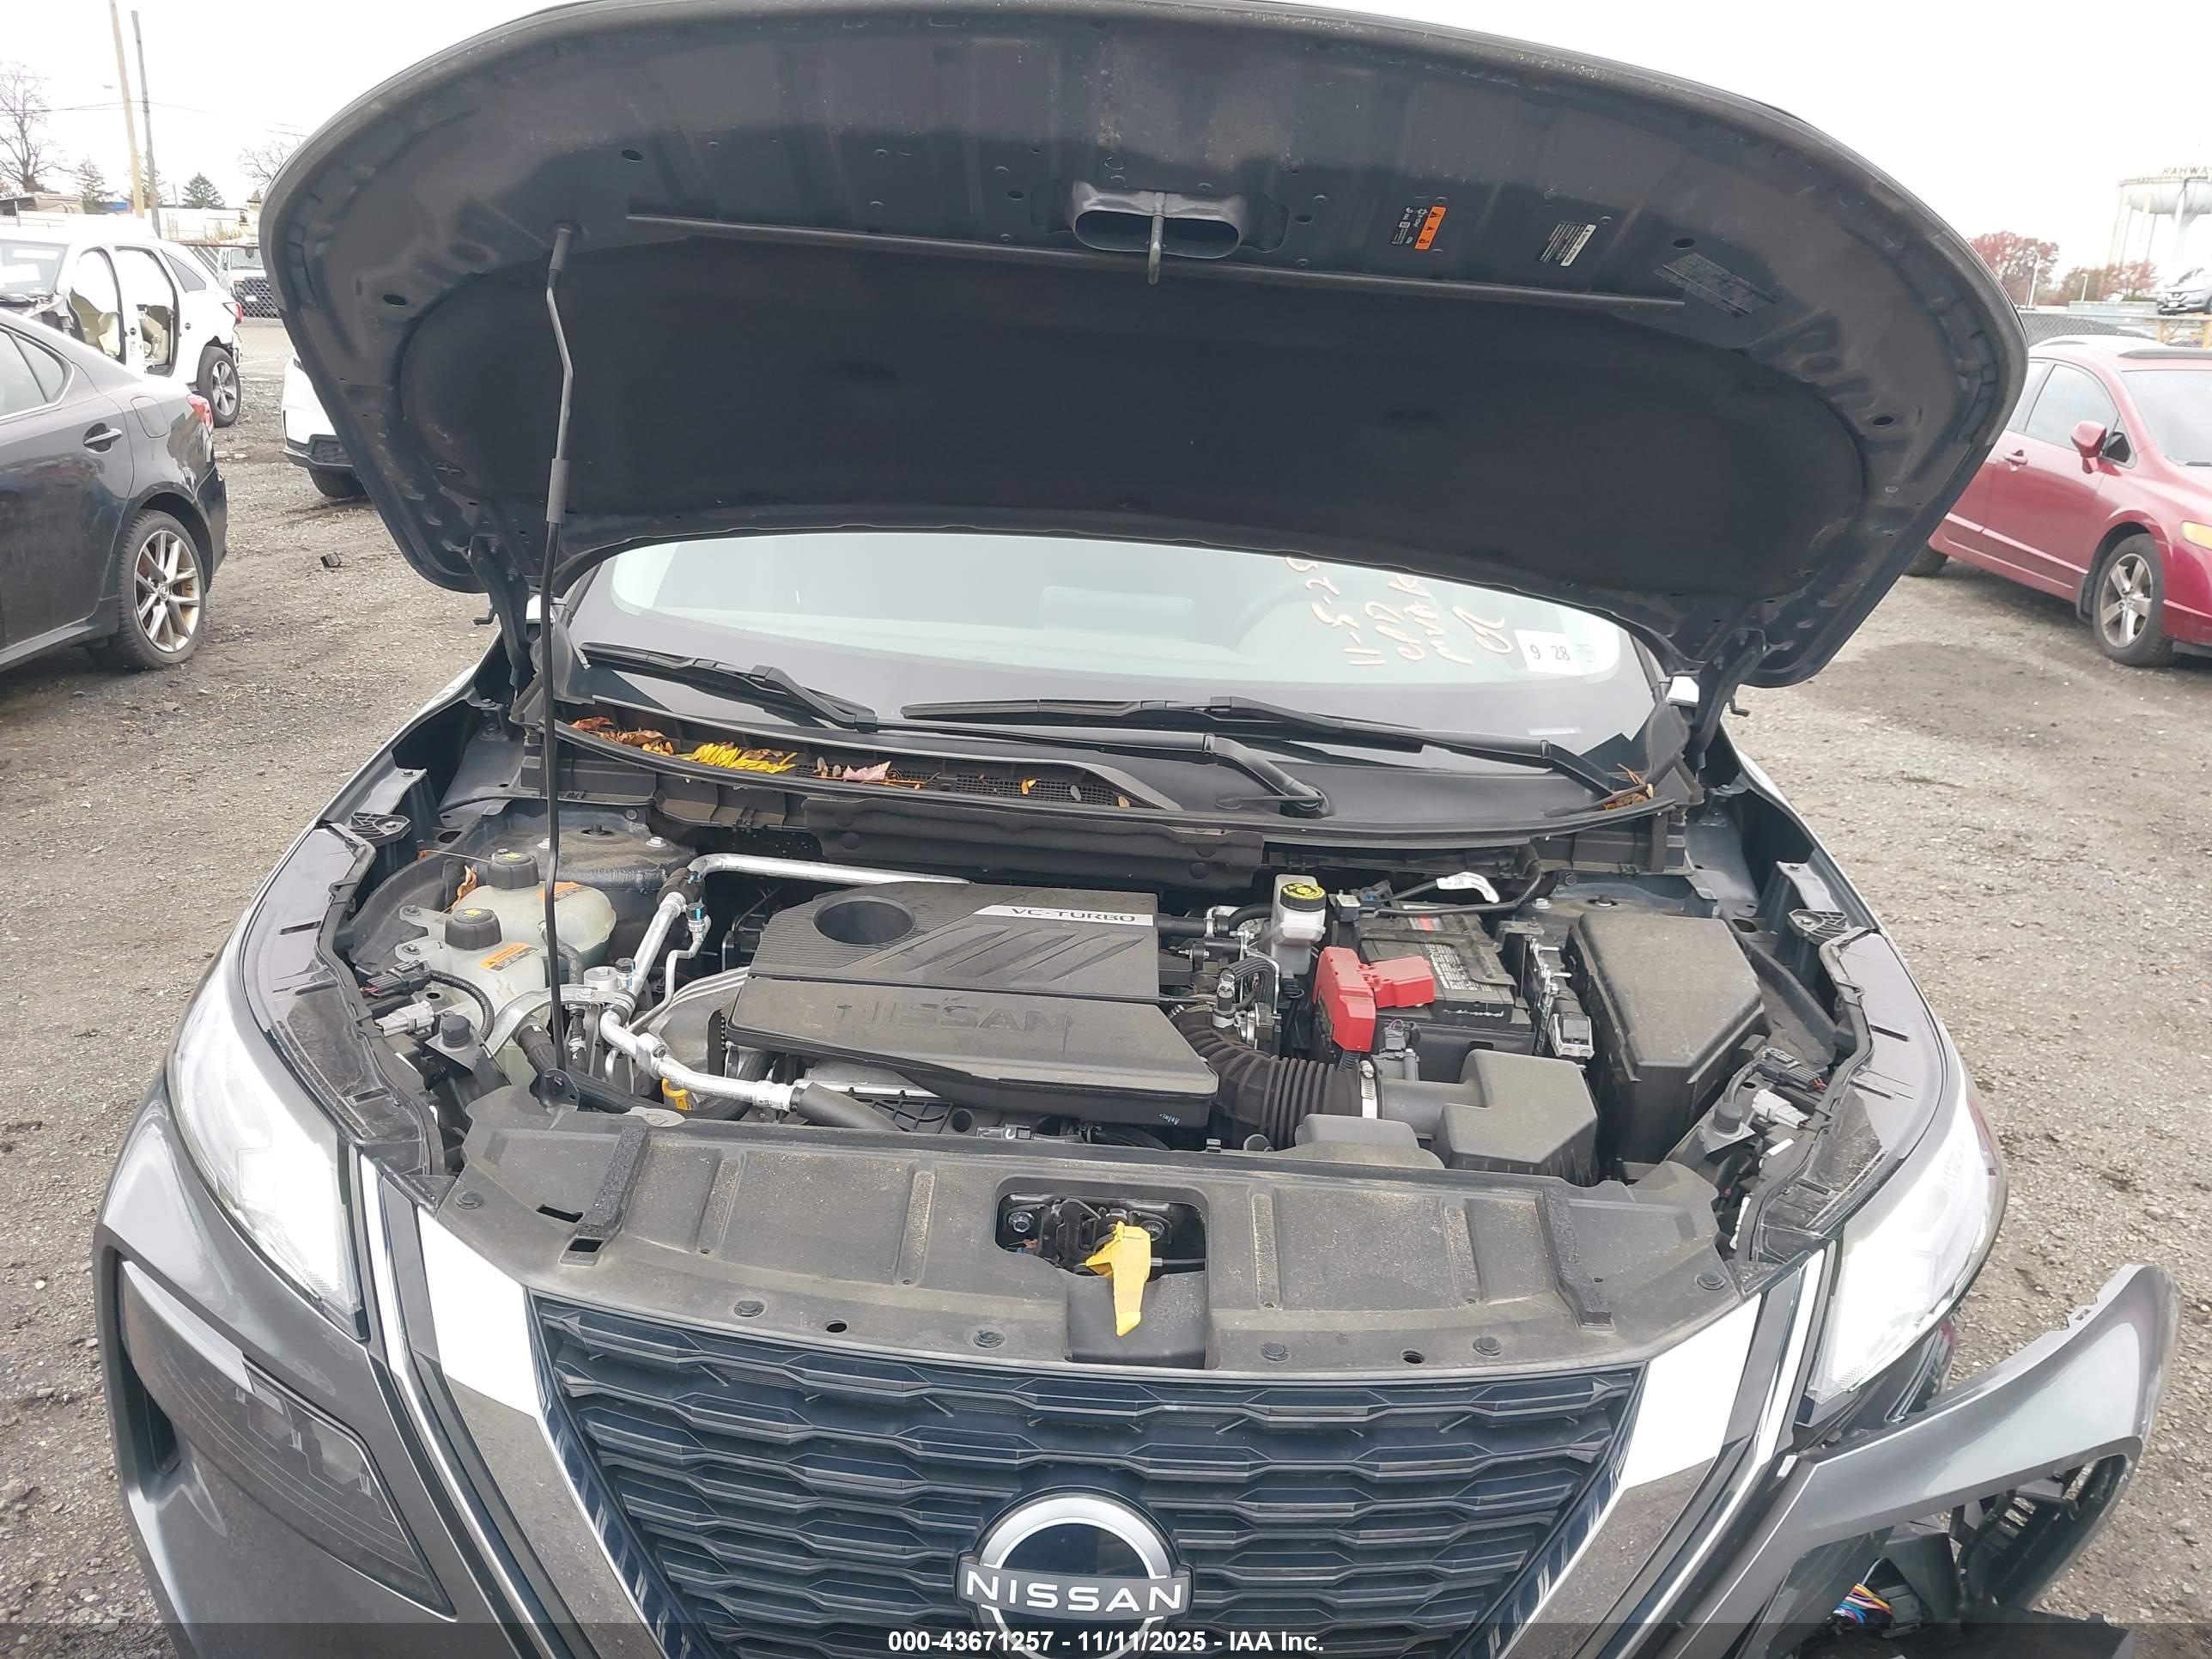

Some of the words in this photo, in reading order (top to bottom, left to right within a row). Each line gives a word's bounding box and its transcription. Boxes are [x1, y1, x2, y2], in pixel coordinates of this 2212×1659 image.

[1530, 644, 1540, 659] 9
[1551, 646, 1571, 660] 28
[1011, 907, 1136, 923] VC-TURBO
[831, 1000, 1072, 1031] NISSAN
[966, 1571, 1183, 1613] NISSAN
